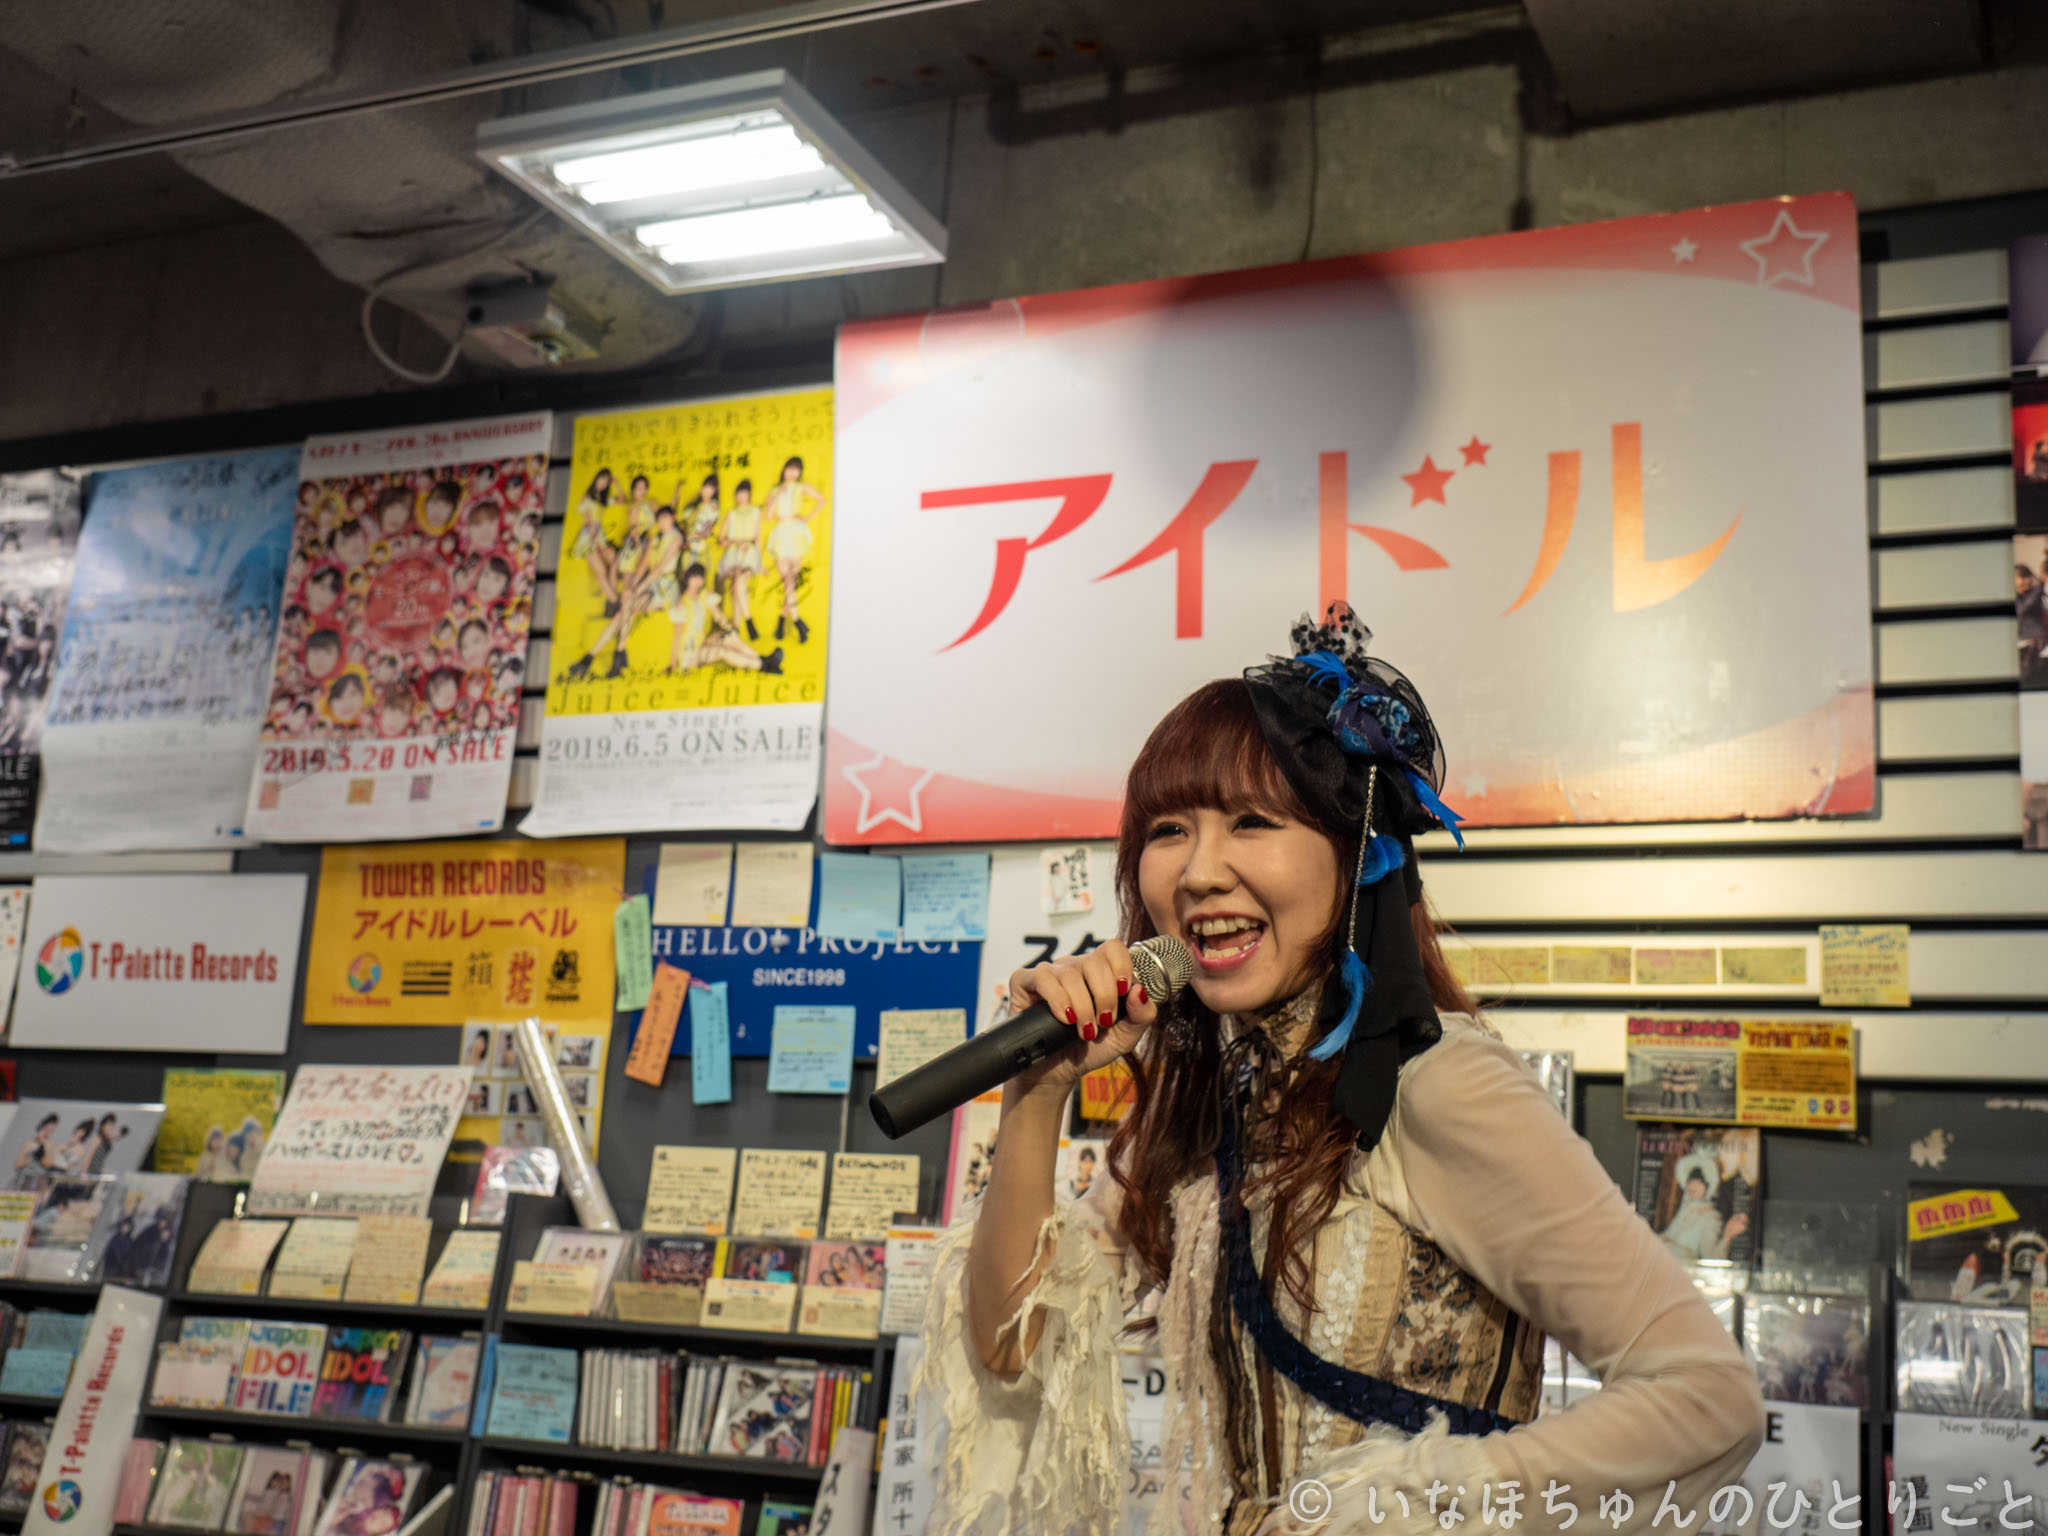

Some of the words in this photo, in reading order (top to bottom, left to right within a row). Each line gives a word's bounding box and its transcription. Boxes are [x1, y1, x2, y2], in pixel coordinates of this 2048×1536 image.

[919, 422, 1744, 654] アイドル
[612, 714, 657, 732] New
[669, 710, 744, 731] Single
[404, 743, 438, 769] ON
[449, 734, 506, 764] SALE
[546, 732, 669, 762] 2019.6.5
[681, 729, 724, 752] ON
[733, 726, 814, 752] SALE
[359, 862, 434, 898] TOWER
[442, 859, 545, 896] RECORDS
[353, 907, 578, 940] アイドルレーベル
[191, 942, 278, 982] Records
[251, 1325, 324, 1348] Japan
[332, 1328, 399, 1351] Japan
[242, 1348, 315, 1380] IDOL
[321, 1350, 389, 1385] IDOL
[235, 1379, 312, 1416] FILE
[312, 1382, 386, 1417] FILE
[1939, 1419, 1975, 1434] New
[1981, 1420, 2029, 1441] Single
